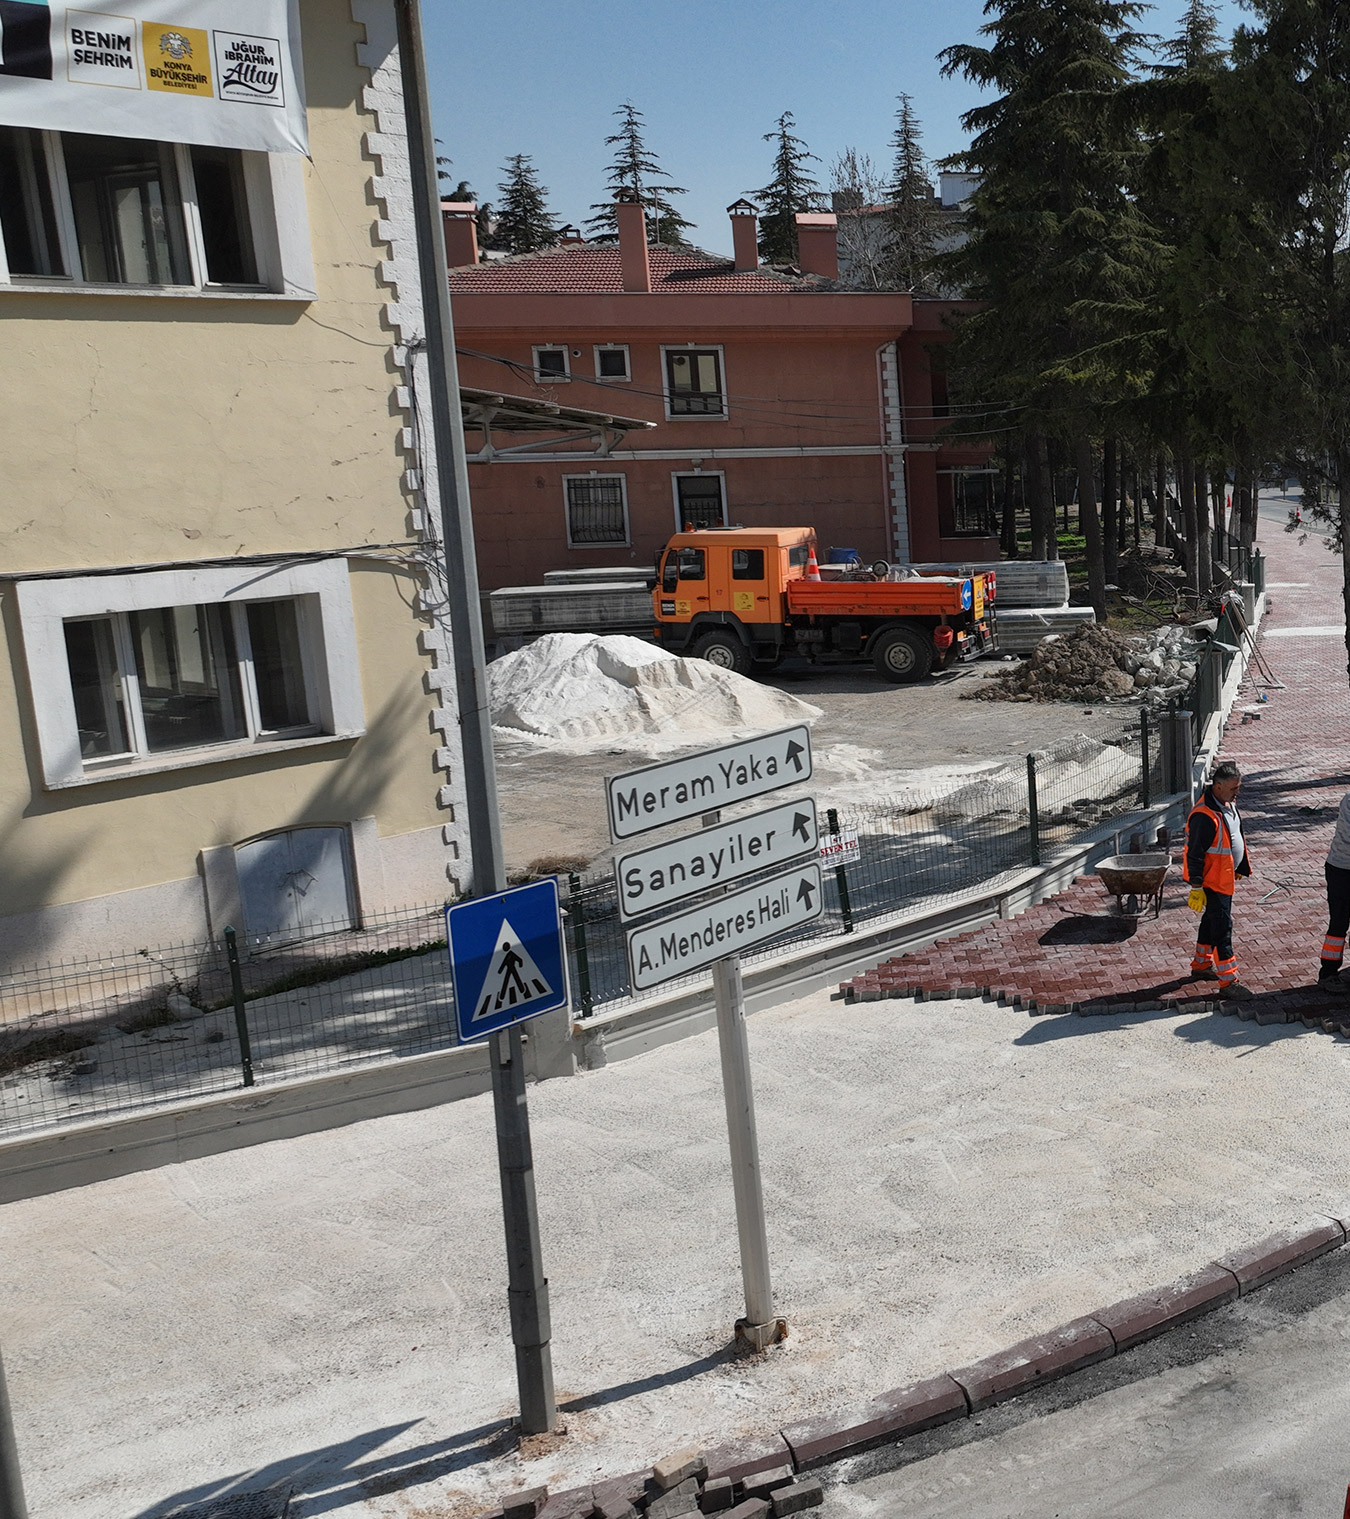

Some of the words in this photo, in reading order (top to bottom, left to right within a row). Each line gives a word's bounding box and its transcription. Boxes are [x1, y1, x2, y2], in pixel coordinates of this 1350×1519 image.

[71, 28, 131, 52] BENİM
[231, 41, 265, 55] UĞUR
[74, 49, 133, 70] ŞEHRİM
[164, 61, 192, 72] KONYA
[224, 50, 274, 66] İBRAHİM
[150, 68, 208, 84] BÜYÜKŞEHİR
[163, 80, 197, 90] BELEDİYESİ
[223, 62, 279, 94] Altay
[617, 775, 715, 822] Meram
[718, 754, 778, 789] Yaka
[820, 843, 843, 857] SEVEN
[625, 830, 776, 899] Sanayiler
[758, 888, 790, 925] Hali
